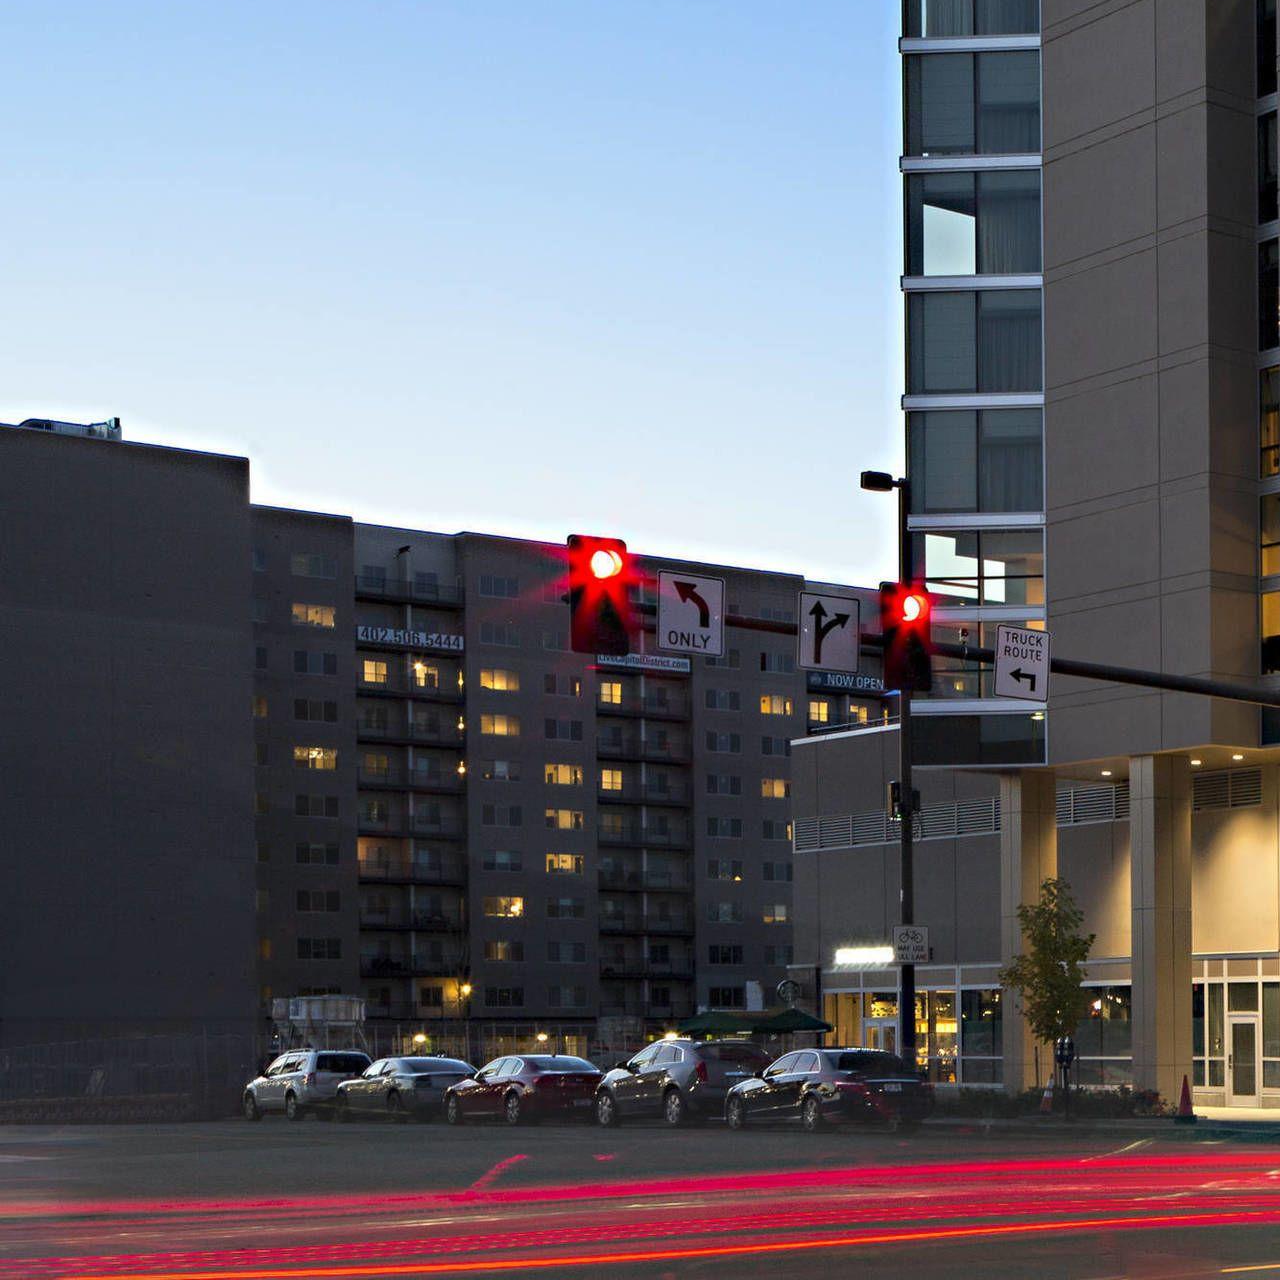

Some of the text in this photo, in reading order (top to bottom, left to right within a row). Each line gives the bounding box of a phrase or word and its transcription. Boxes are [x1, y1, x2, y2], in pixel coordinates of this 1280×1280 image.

[668, 630, 711, 649] ONLY
[1005, 631, 1043, 648] TRUCK
[1004, 645, 1042, 662] ROUTE
[827, 673, 884, 690] NOW OPEN
